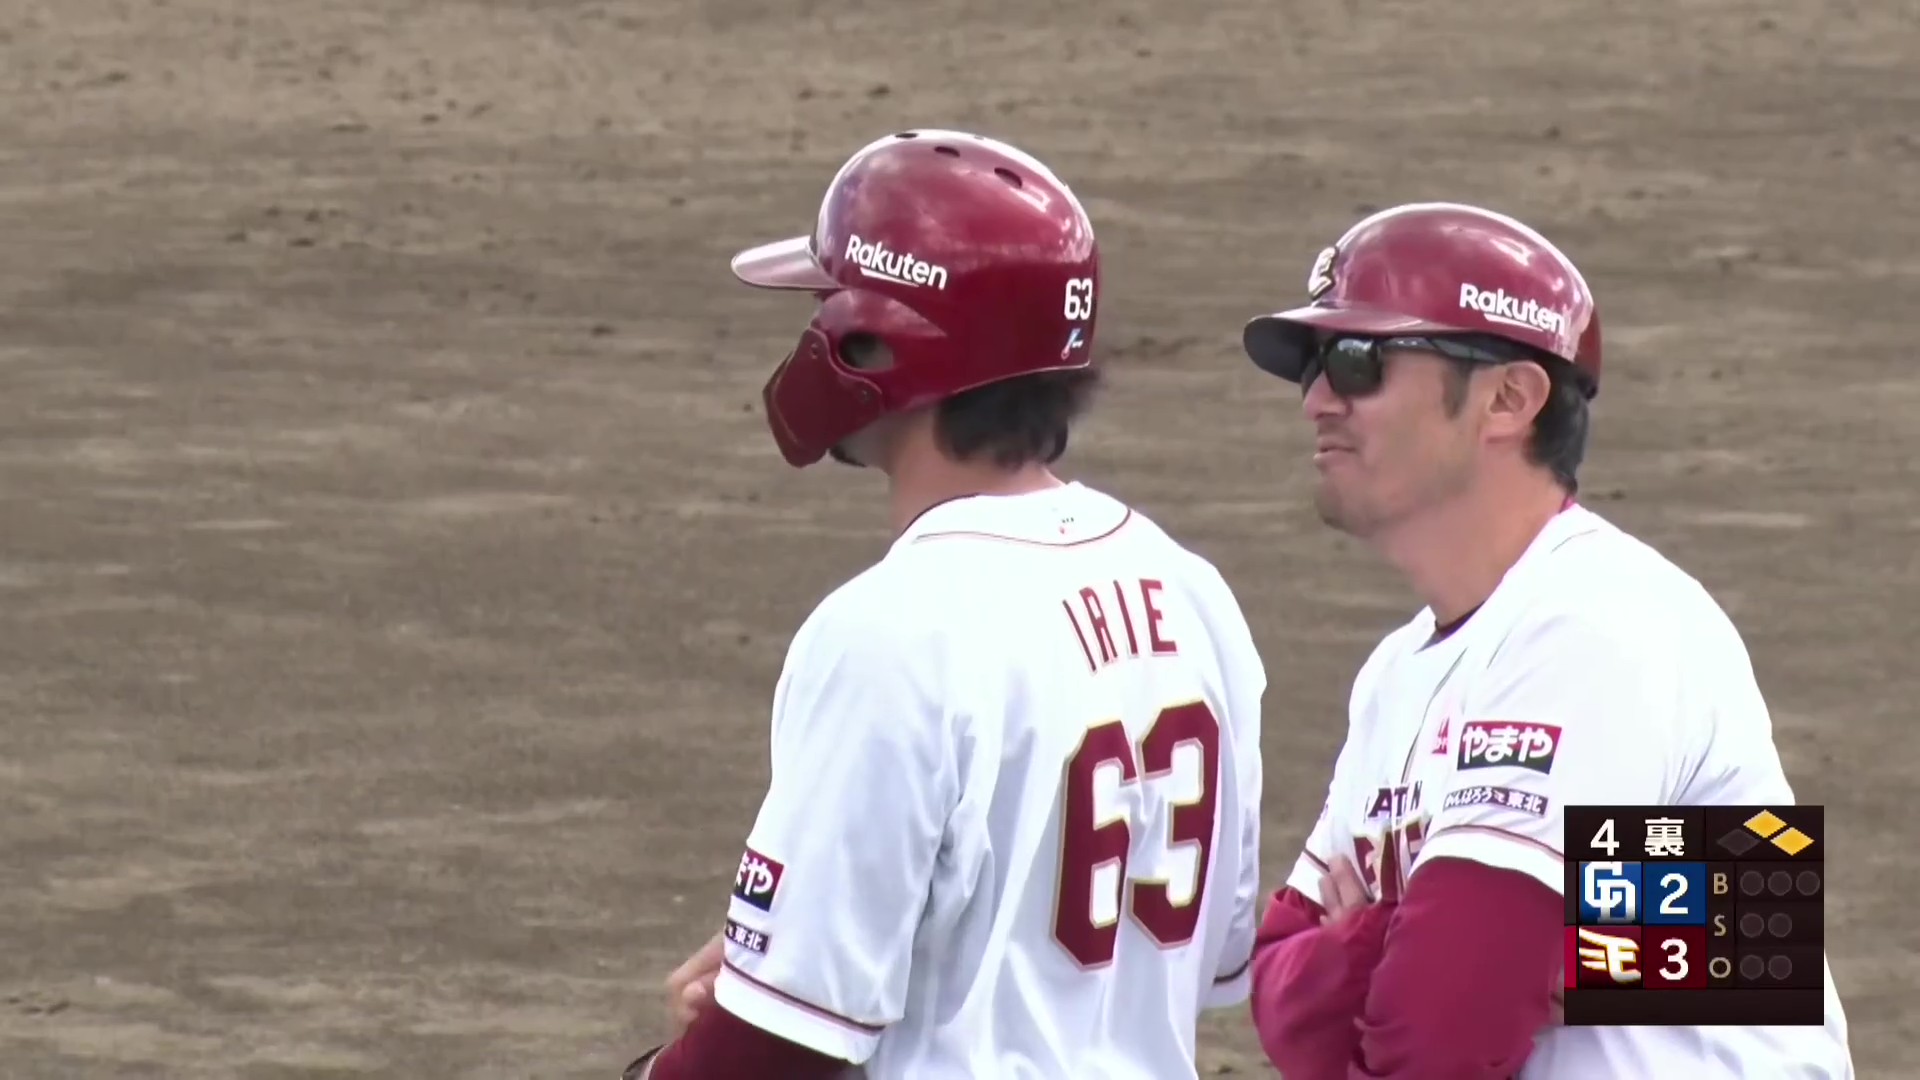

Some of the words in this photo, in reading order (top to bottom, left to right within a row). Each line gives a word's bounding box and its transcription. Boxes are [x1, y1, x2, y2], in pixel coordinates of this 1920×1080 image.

[844, 234, 948, 290] Rakuten
[1063, 278, 1093, 320] 63
[1458, 283, 1566, 336] Rakuten
[1062, 578, 1177, 673] IRIE
[1462, 725, 1553, 763] やまや
[1050, 697, 1220, 968] 63
